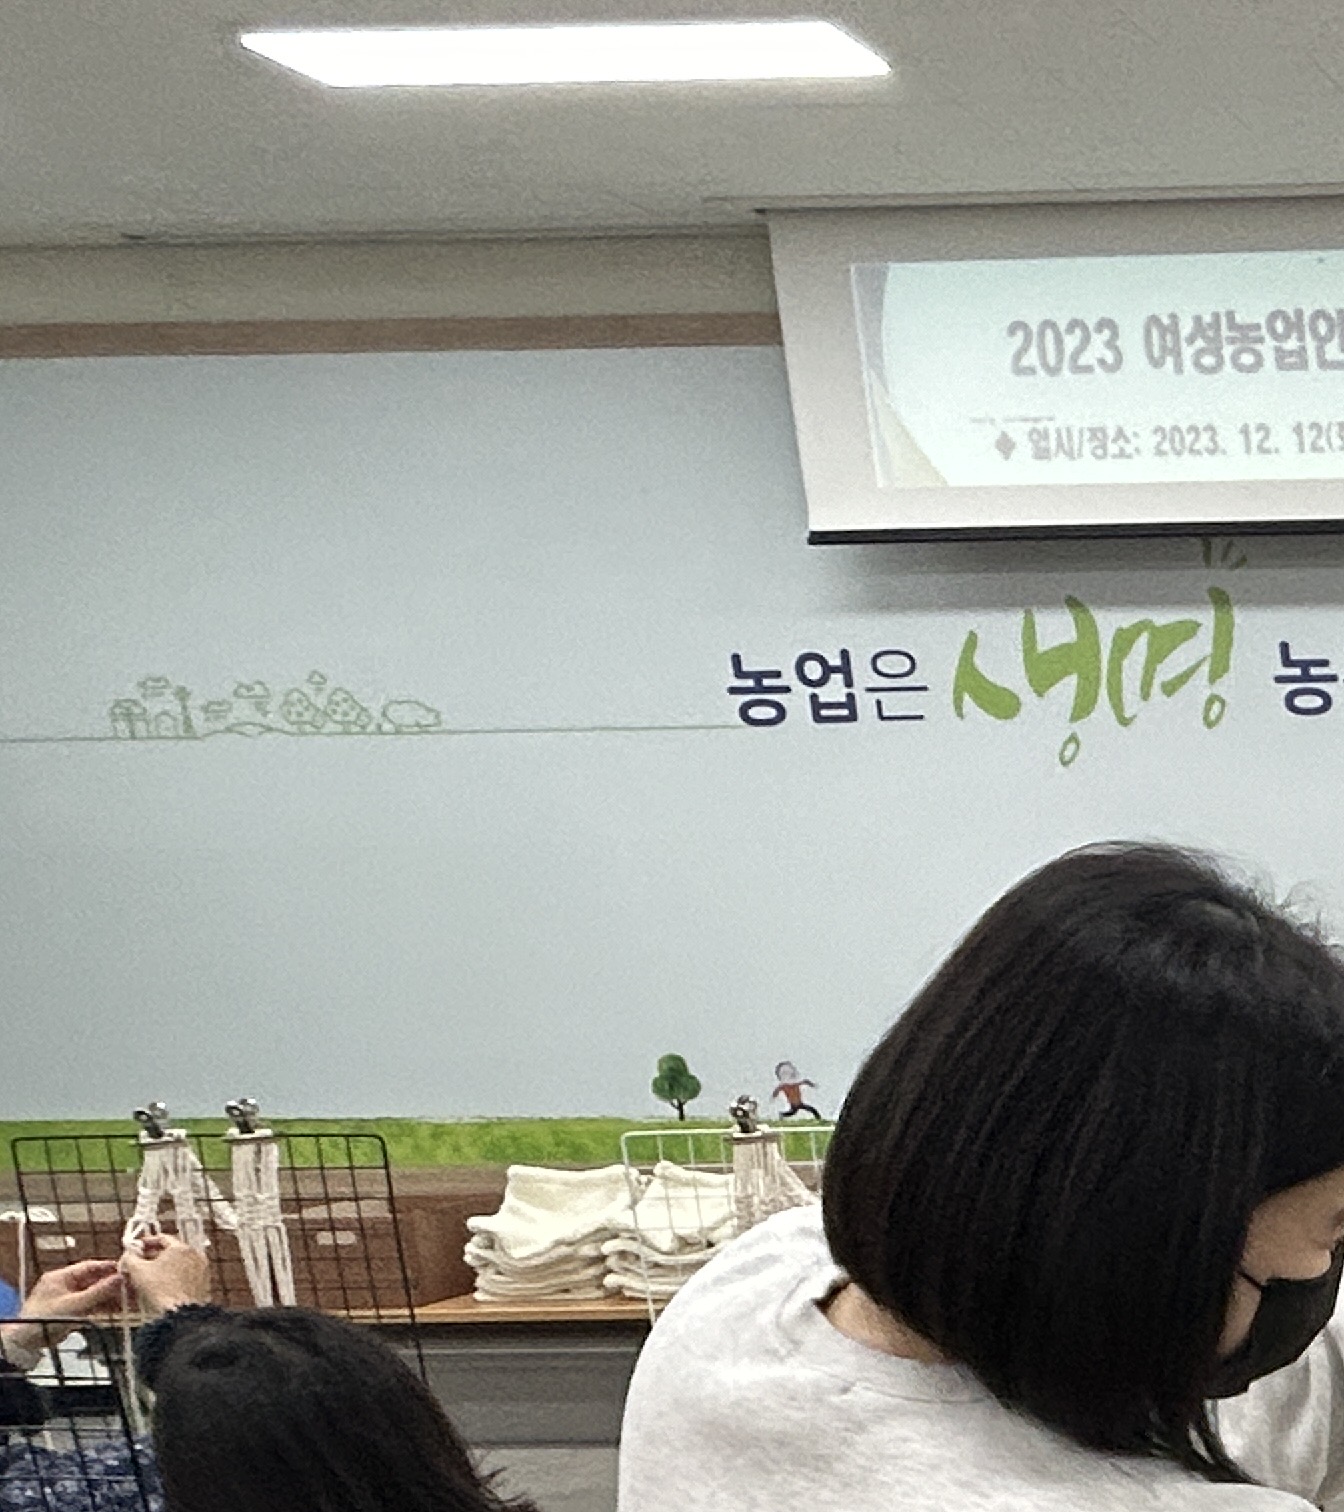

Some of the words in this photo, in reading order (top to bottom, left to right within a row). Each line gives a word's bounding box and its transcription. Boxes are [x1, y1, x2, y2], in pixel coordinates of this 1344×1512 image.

[1006, 317, 1124, 377] 2023
[1027, 424, 1141, 461] 일시/장소:
[1152, 423, 1227, 457] 2023.
[1238, 421, 1280, 456] 12.
[727, 647, 929, 727] 농업은
[952, 586, 1237, 768] 생명
